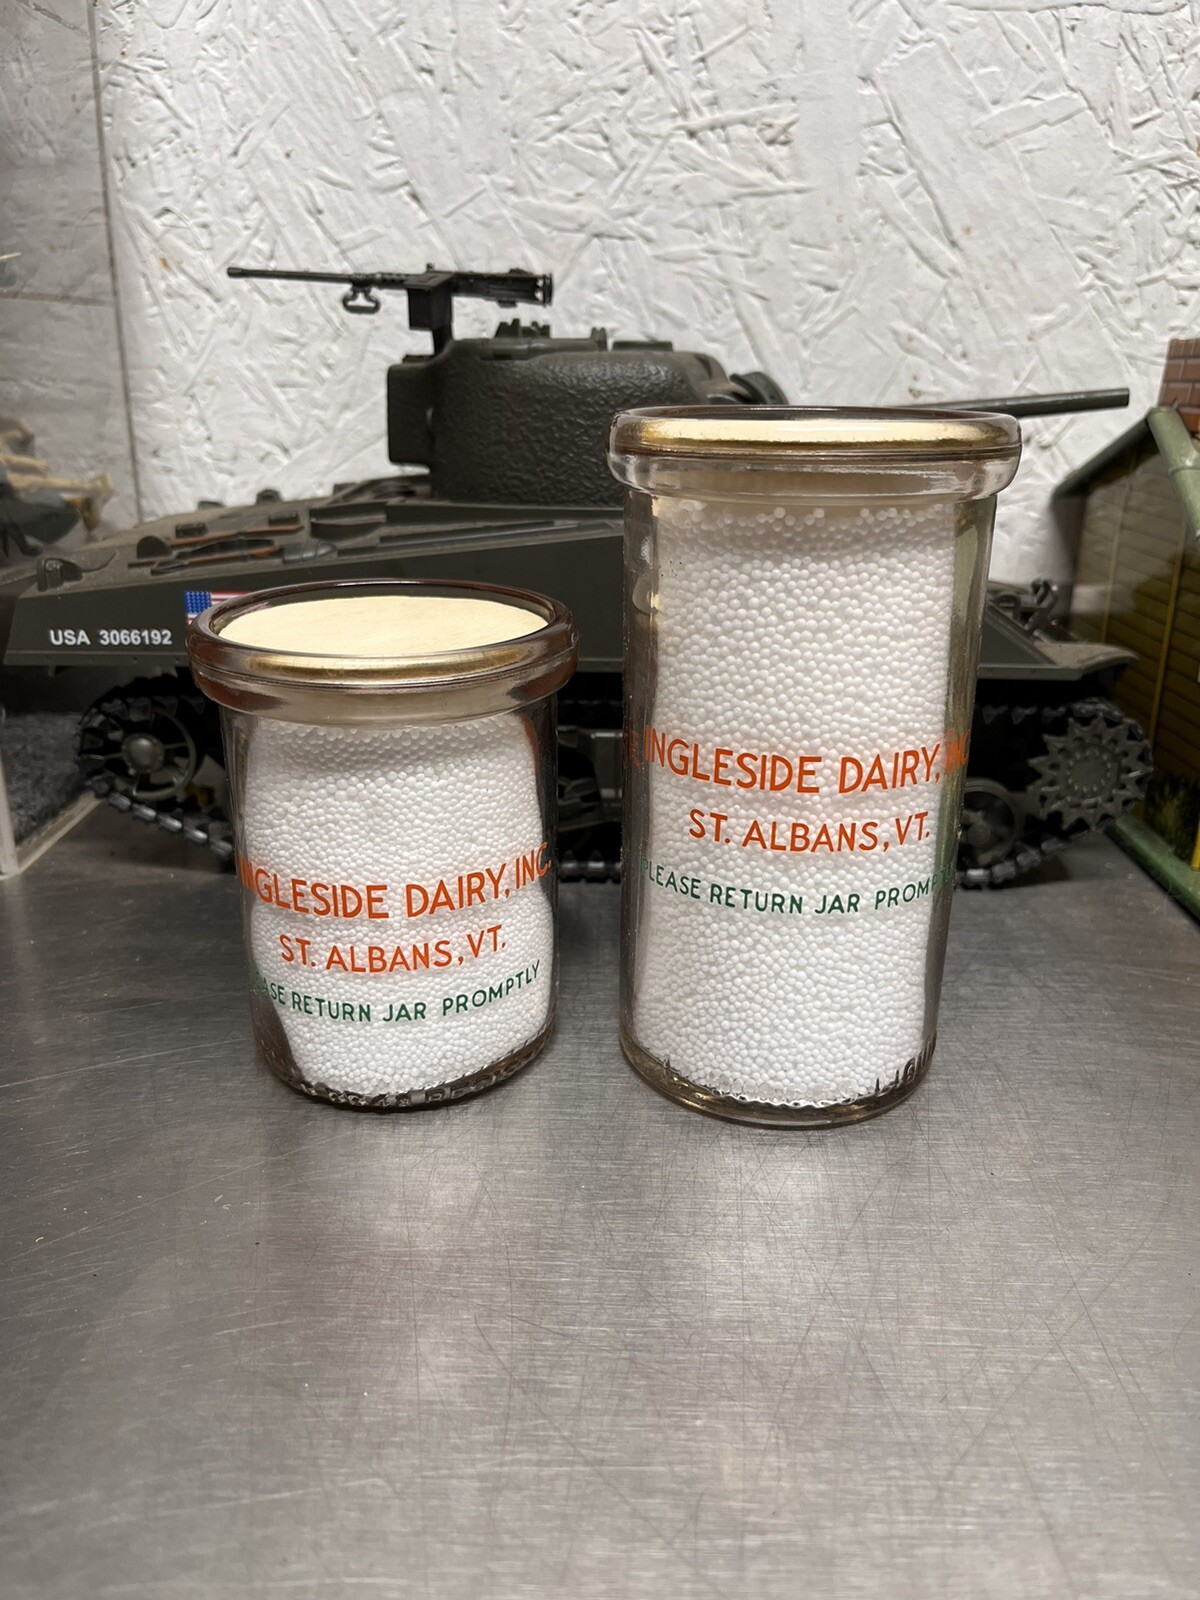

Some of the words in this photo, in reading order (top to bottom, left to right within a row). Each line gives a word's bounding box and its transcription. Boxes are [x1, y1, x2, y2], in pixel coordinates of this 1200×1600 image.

[49, 629, 91, 646] USA
[98, 629, 173, 646] 3066192
[644, 724, 823, 795] INGLESIDE
[837, 743, 941, 795] DAIRY,
[688, 808, 731, 846] ST.
[742, 819, 891, 853] ALBANS,
[894, 811, 930, 846] VT.
[404, 863, 510, 919] DAIRY,
[709, 883, 803, 914] RETURN
[814, 893, 860, 914] JAR
[279, 934, 317, 968] ST.
[325, 939, 465, 973] ALBANS,
[466, 924, 507, 959] VT.
[291, 990, 371, 1022] RETURN
[382, 1002, 427, 1022] JAR
[442, 959, 541, 1017] PROMPTLY
